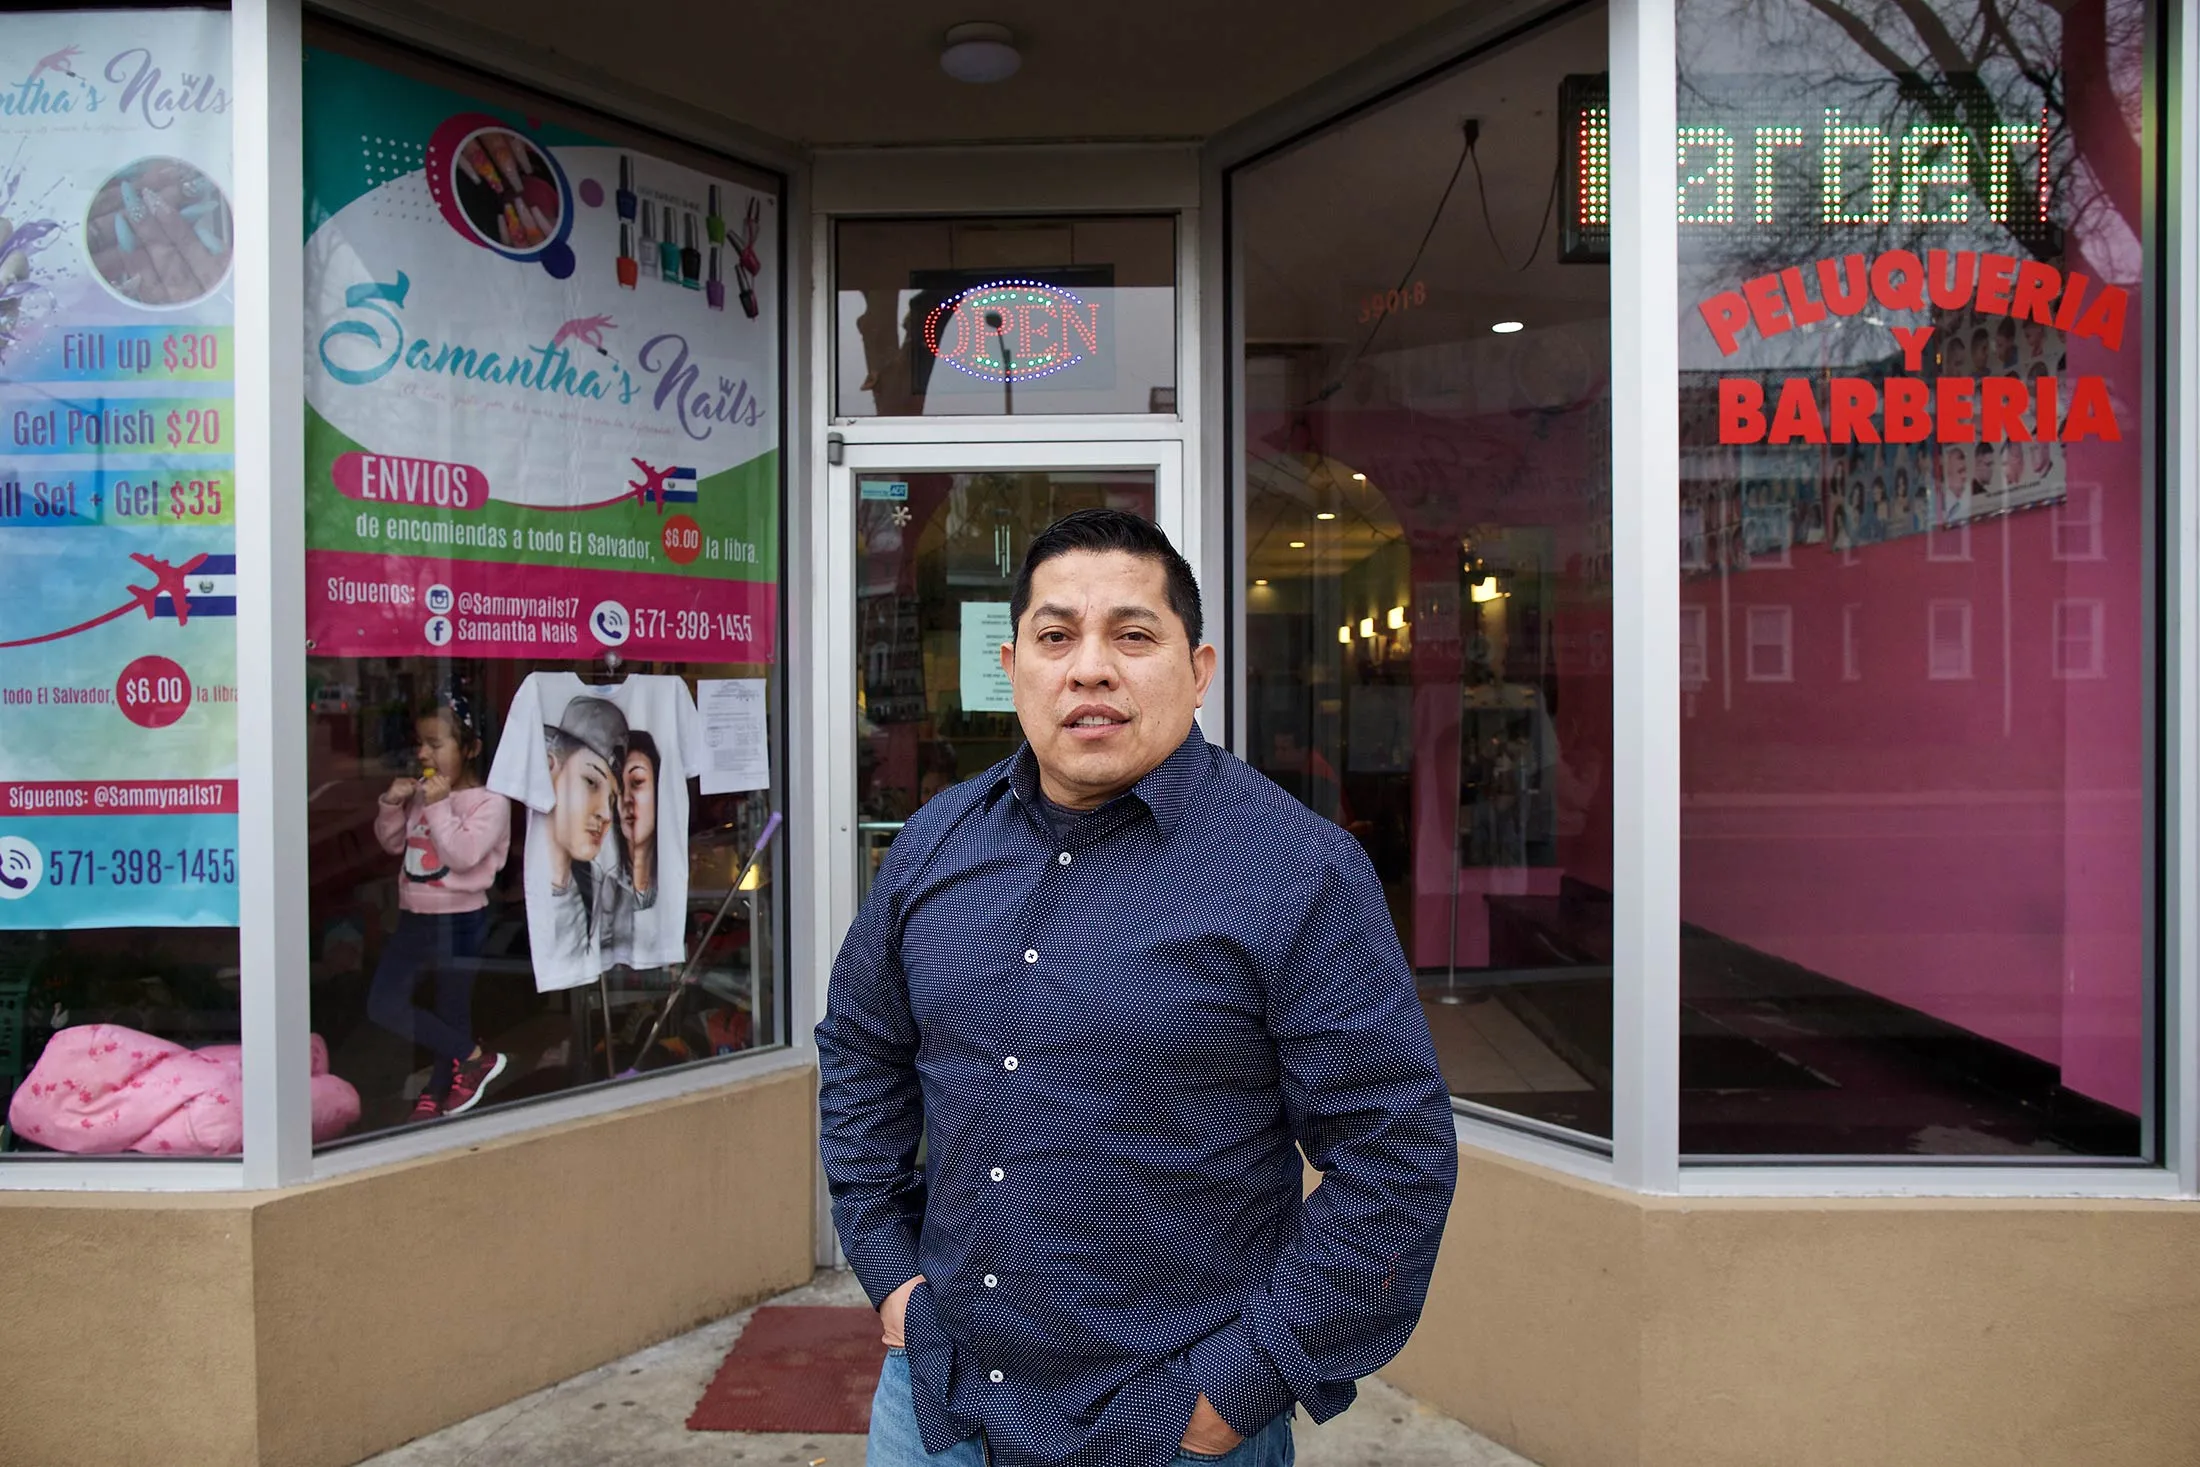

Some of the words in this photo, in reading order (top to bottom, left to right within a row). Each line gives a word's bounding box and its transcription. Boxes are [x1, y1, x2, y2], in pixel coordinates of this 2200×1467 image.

[104, 48, 233, 130] Nails
[1698, 249, 2129, 358] PELUQUERIA
[923, 299, 1100, 358] OPEN
[1891, 326, 1935, 372] Y
[63, 333, 105, 371] Fill
[117, 338, 151, 374] up
[163, 333, 218, 373] $30
[319, 269, 641, 405] Samantha's
[638, 333, 766, 441] Nails
[13, 409, 56, 446] Gel
[68, 409, 155, 445] Polish
[166, 408, 220, 449] $20
[1718, 375, 2123, 445] BARBERIA
[0, 481, 22, 517] ll
[33, 480, 79, 517] Set
[115, 480, 159, 517] Gel
[170, 480, 222, 520] $35
[361, 455, 469, 508] ENVIOS
[356, 512, 379, 539] de
[386, 515, 507, 549] encomiendas
[513, 531, 522, 549] a
[528, 527, 564, 554] todo
[569, 530, 582, 555] El
[588, 532, 655, 564] Salvador,
[664, 527, 699, 550] $6.00
[705, 535, 719, 560] la
[724, 537, 759, 564] libra.
[327, 576, 416, 605] Síguenos:
[458, 592, 580, 620] @Sammynails17
[458, 618, 537, 643] Samantha
[541, 621, 578, 644] Nails
[634, 608, 752, 642] 571-398-1455
[3, 687, 33, 704] todo
[37, 687, 48, 704] El
[52, 686, 116, 707] Salvador,
[125, 676, 183, 707] $6.00
[196, 685, 209, 703] la
[9, 785, 89, 810] Síguenos:
[94, 784, 223, 809] @Sammynails17
[50, 848, 236, 886] 571-398-1455
